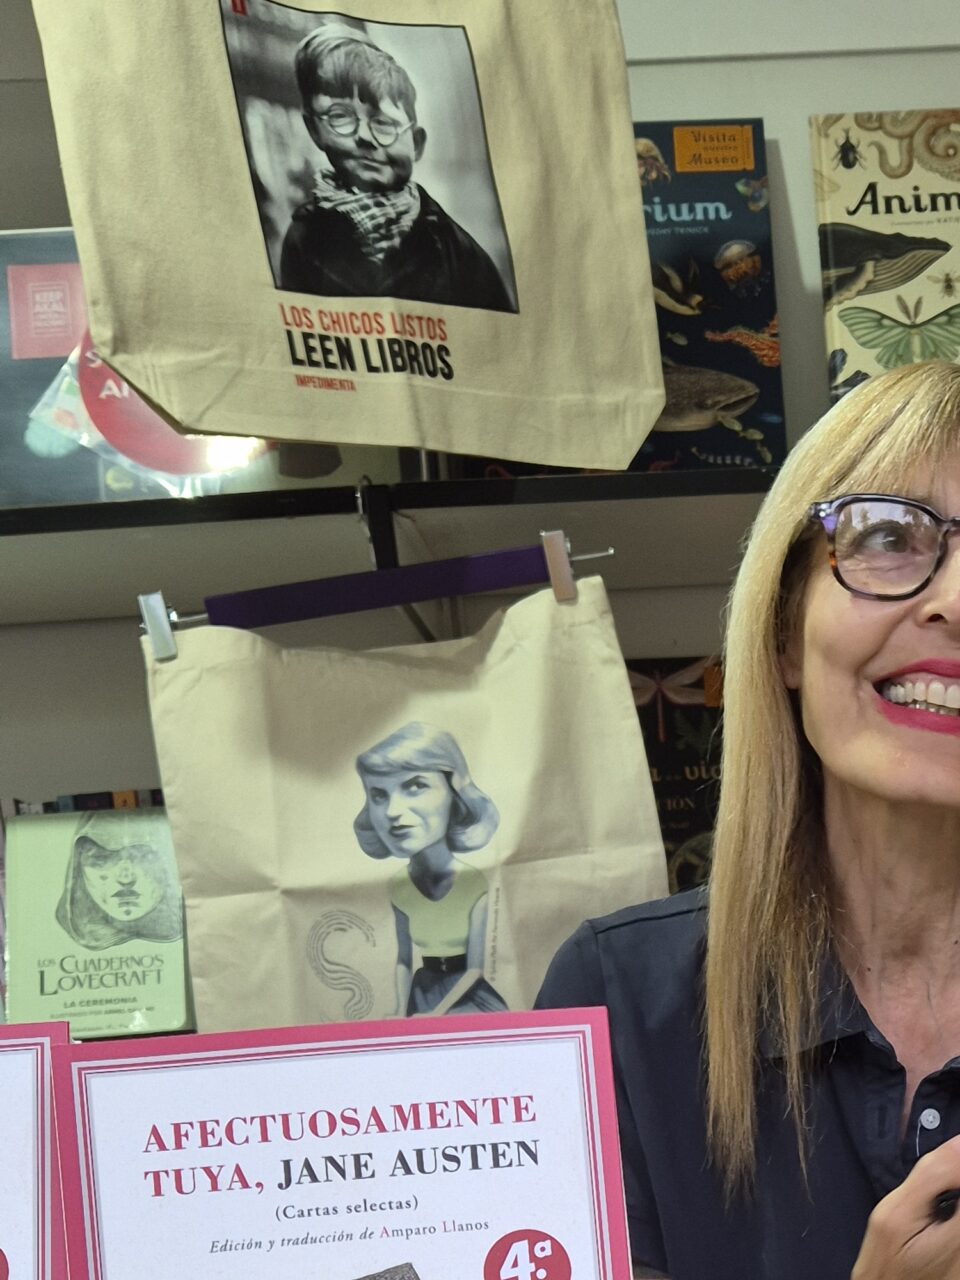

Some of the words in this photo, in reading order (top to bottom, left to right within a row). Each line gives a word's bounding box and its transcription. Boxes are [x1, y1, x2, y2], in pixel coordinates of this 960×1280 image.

[279, 303, 315, 329] LOS
[317, 309, 386, 335] CHICOS
[389, 311, 448, 342] LISTOS
[286, 329, 357, 372] LEEN
[360, 337, 454, 381] LIBROS
[295, 374, 357, 392] IMPEDIMENTA
[60, 954, 164, 975] CUADERNOS
[39, 969, 163, 996] LOVECRAFT
[63, 1001, 76, 1009] LA
[79, 996, 138, 1008] CEREMONIA
[142, 1095, 536, 1153] AFECTUOSAMENTE
[144, 1163, 264, 1198] TUYA,
[277, 1152, 376, 1191] JANE
[391, 1139, 540, 1178] AUSTEN
[275, 1203, 338, 1222] (Cartas
[346, 1195, 419, 1216] selectas)
[210, 1236, 263, 1254] Edición
[265, 1240, 275, 1254] y
[280, 1230, 354, 1249] traducción
[359, 1227, 375, 1240] de
[380, 1222, 437, 1242] Amparo
[442, 1219, 490, 1233] Llanos
